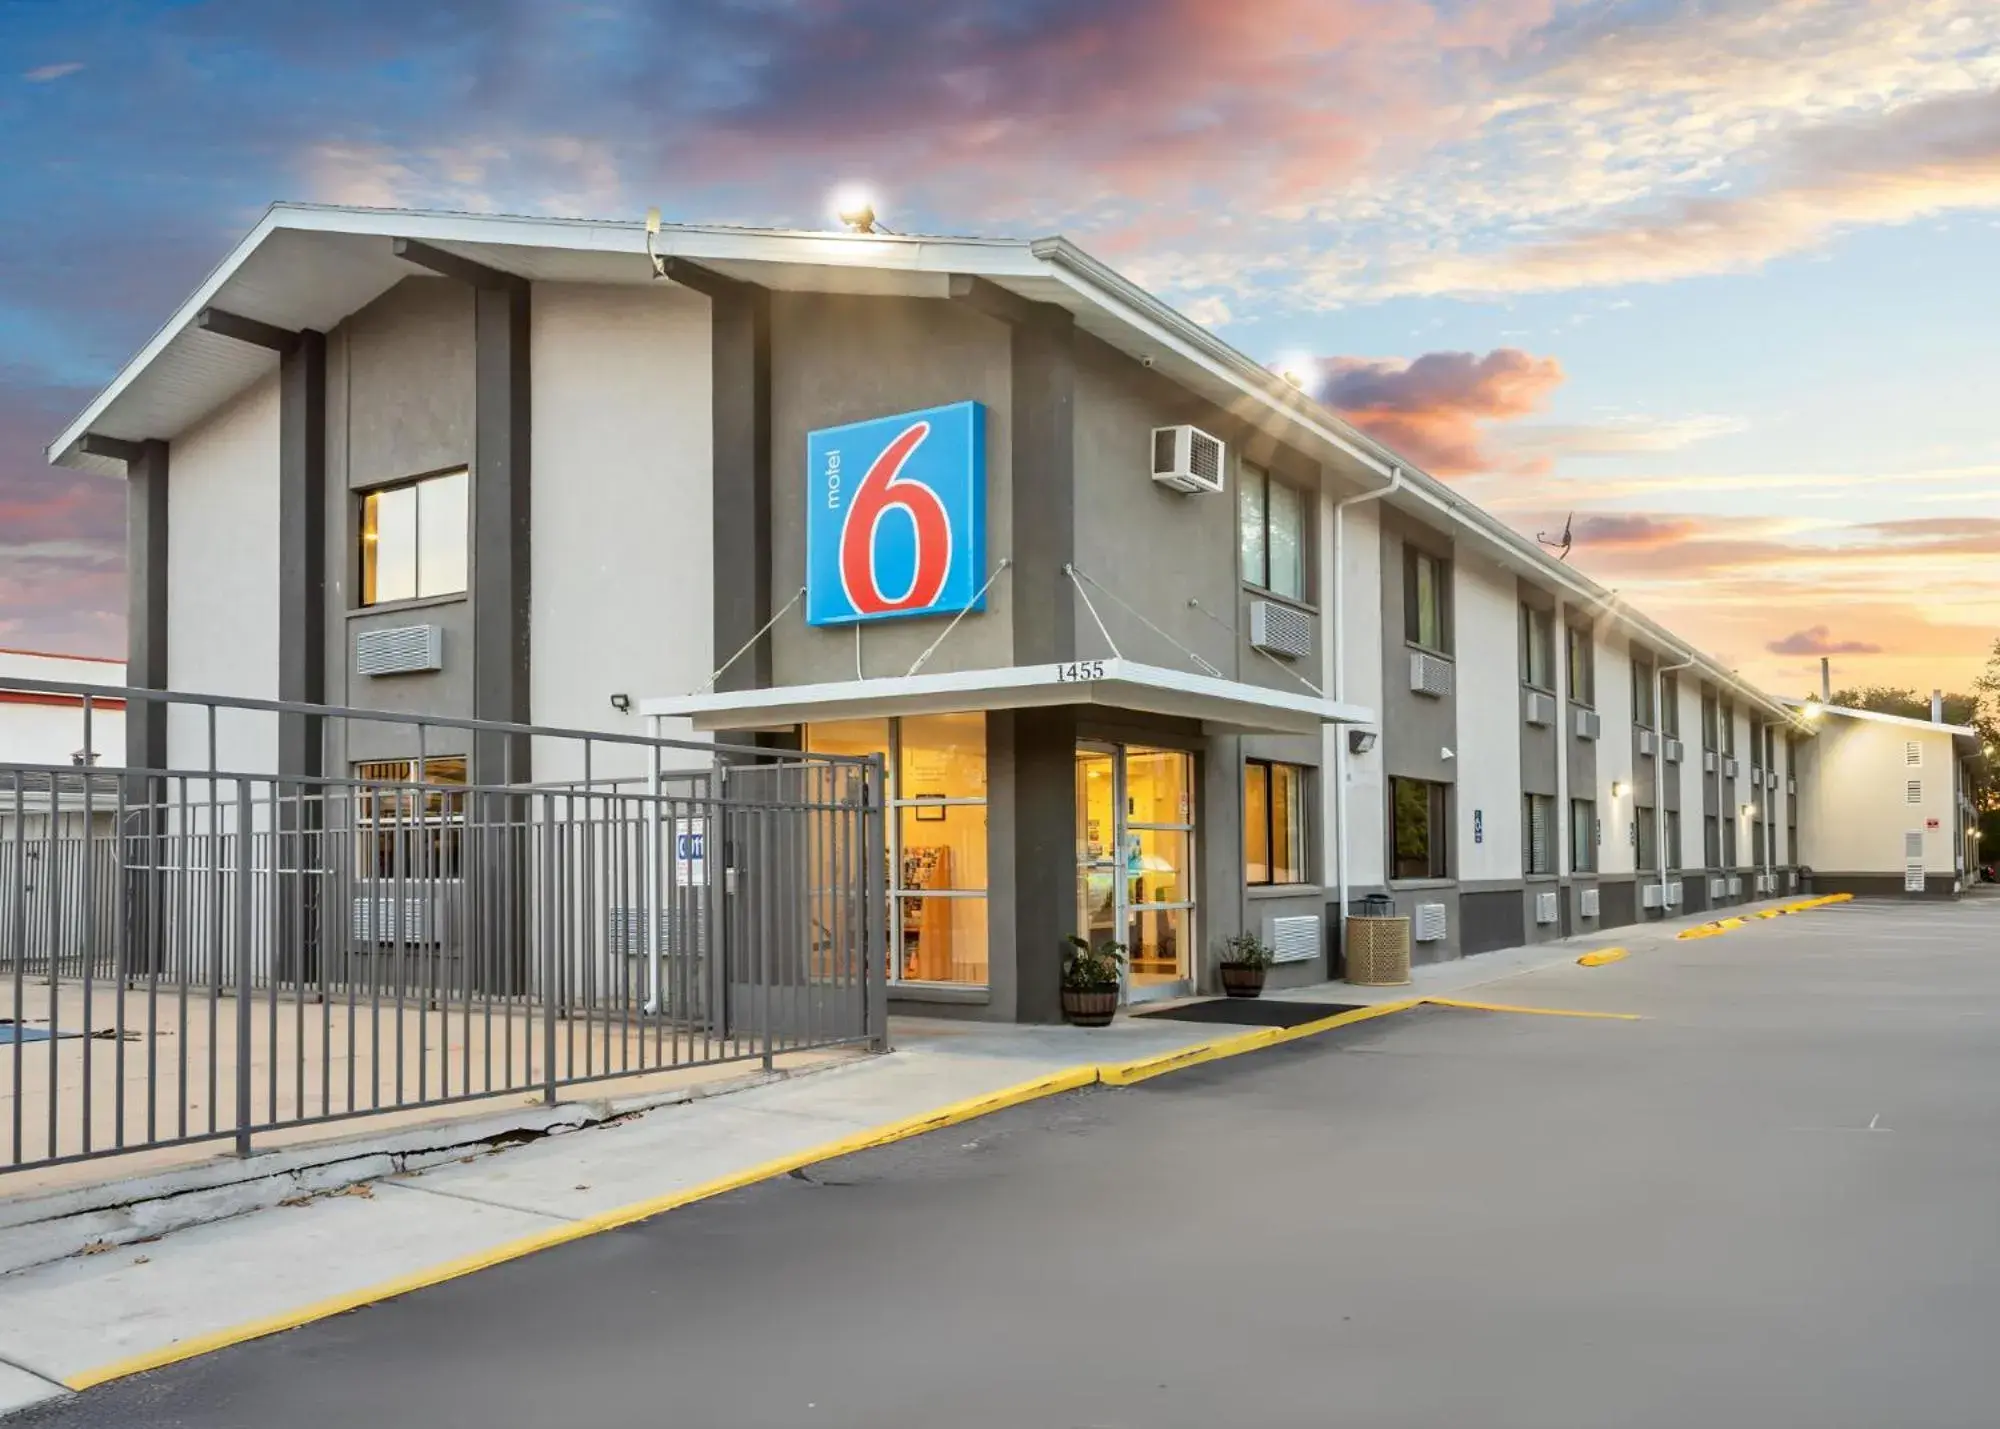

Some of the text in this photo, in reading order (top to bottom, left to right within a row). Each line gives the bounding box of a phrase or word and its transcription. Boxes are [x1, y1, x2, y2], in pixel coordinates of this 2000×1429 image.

[824, 420, 952, 614] motel 6
[1057, 661, 1104, 682] 1455
